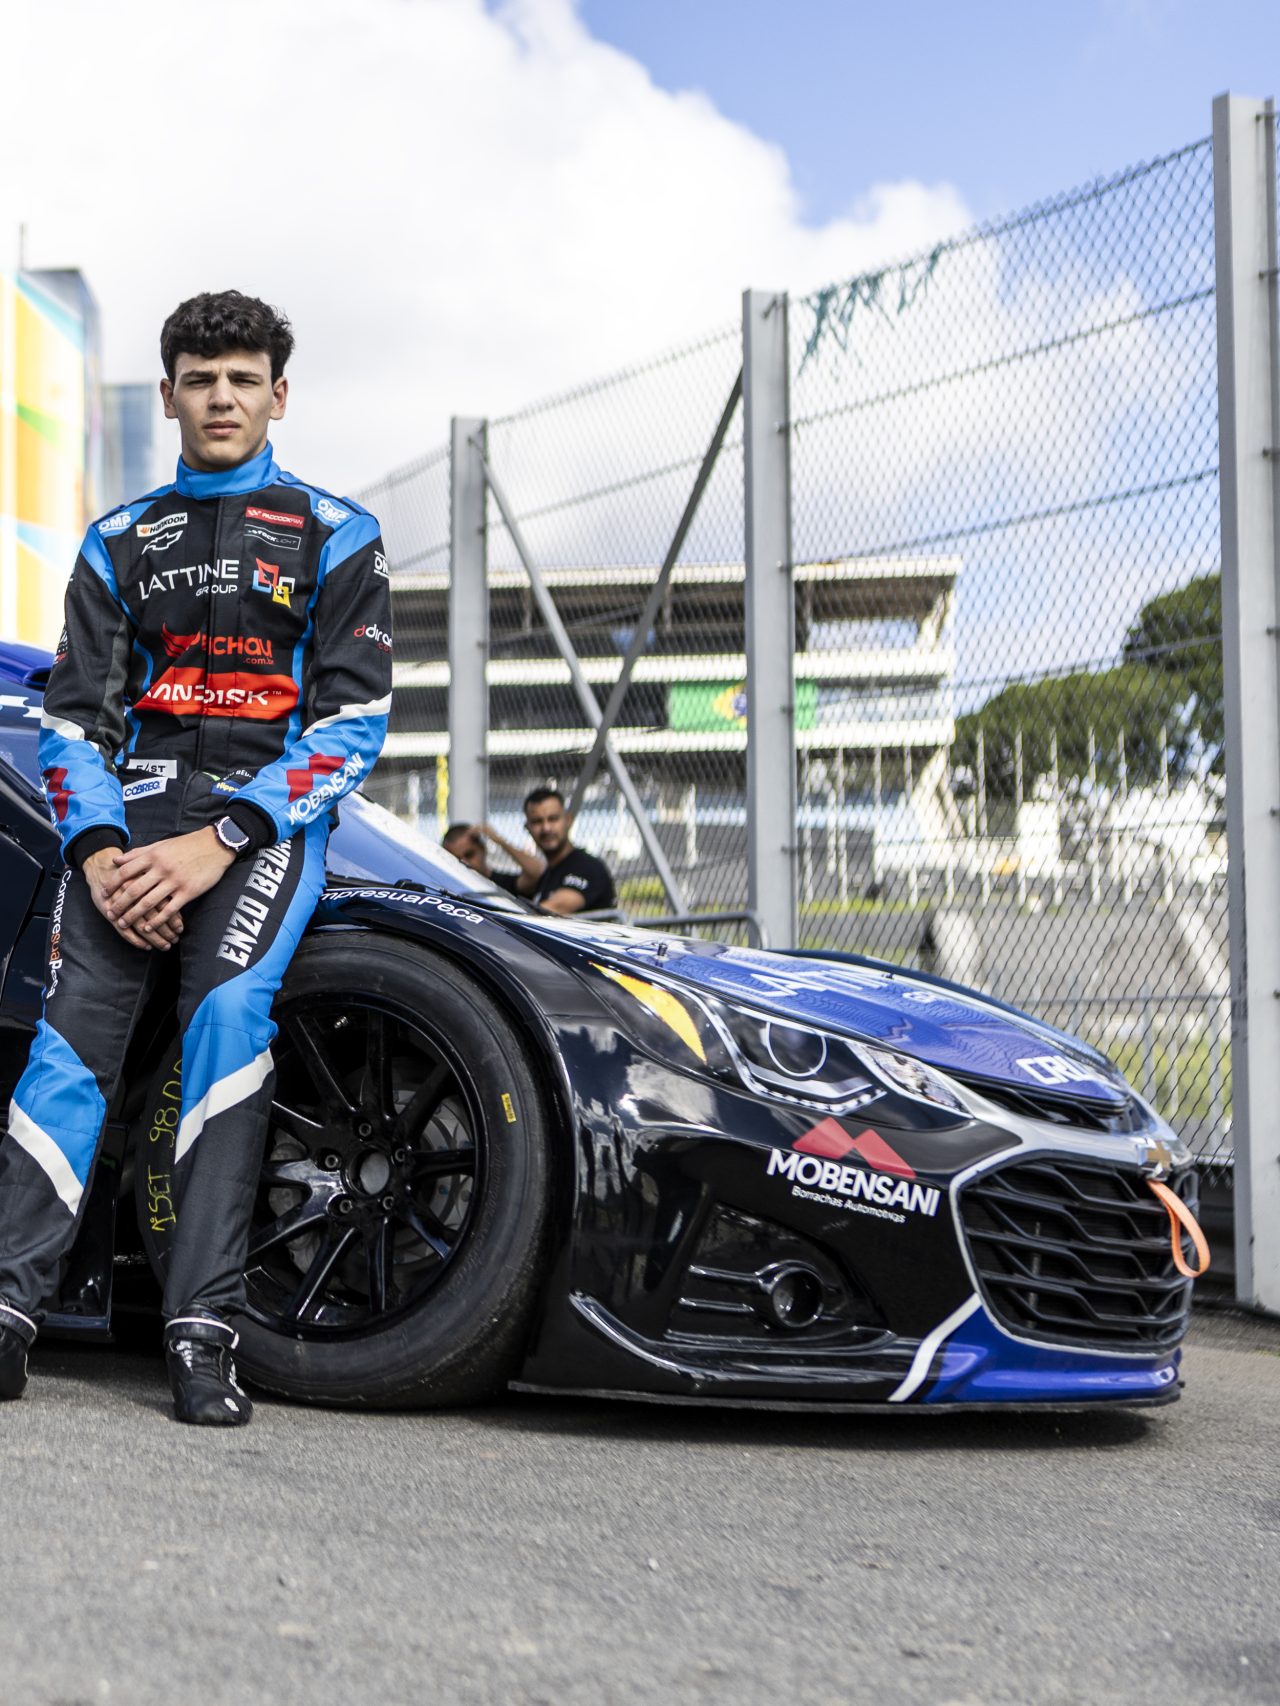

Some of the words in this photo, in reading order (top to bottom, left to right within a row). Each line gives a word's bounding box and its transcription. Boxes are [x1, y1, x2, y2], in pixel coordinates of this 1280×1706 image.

[99, 515, 131, 530] OMP
[139, 559, 240, 600] LATTINE
[195, 584, 238, 597] GROUP
[216, 894, 270, 968] ENZO
[766, 1148, 941, 1217] MOBENSANI
[791, 1185, 844, 1208] Borrachas
[843, 1199, 907, 1224] Automotivas
